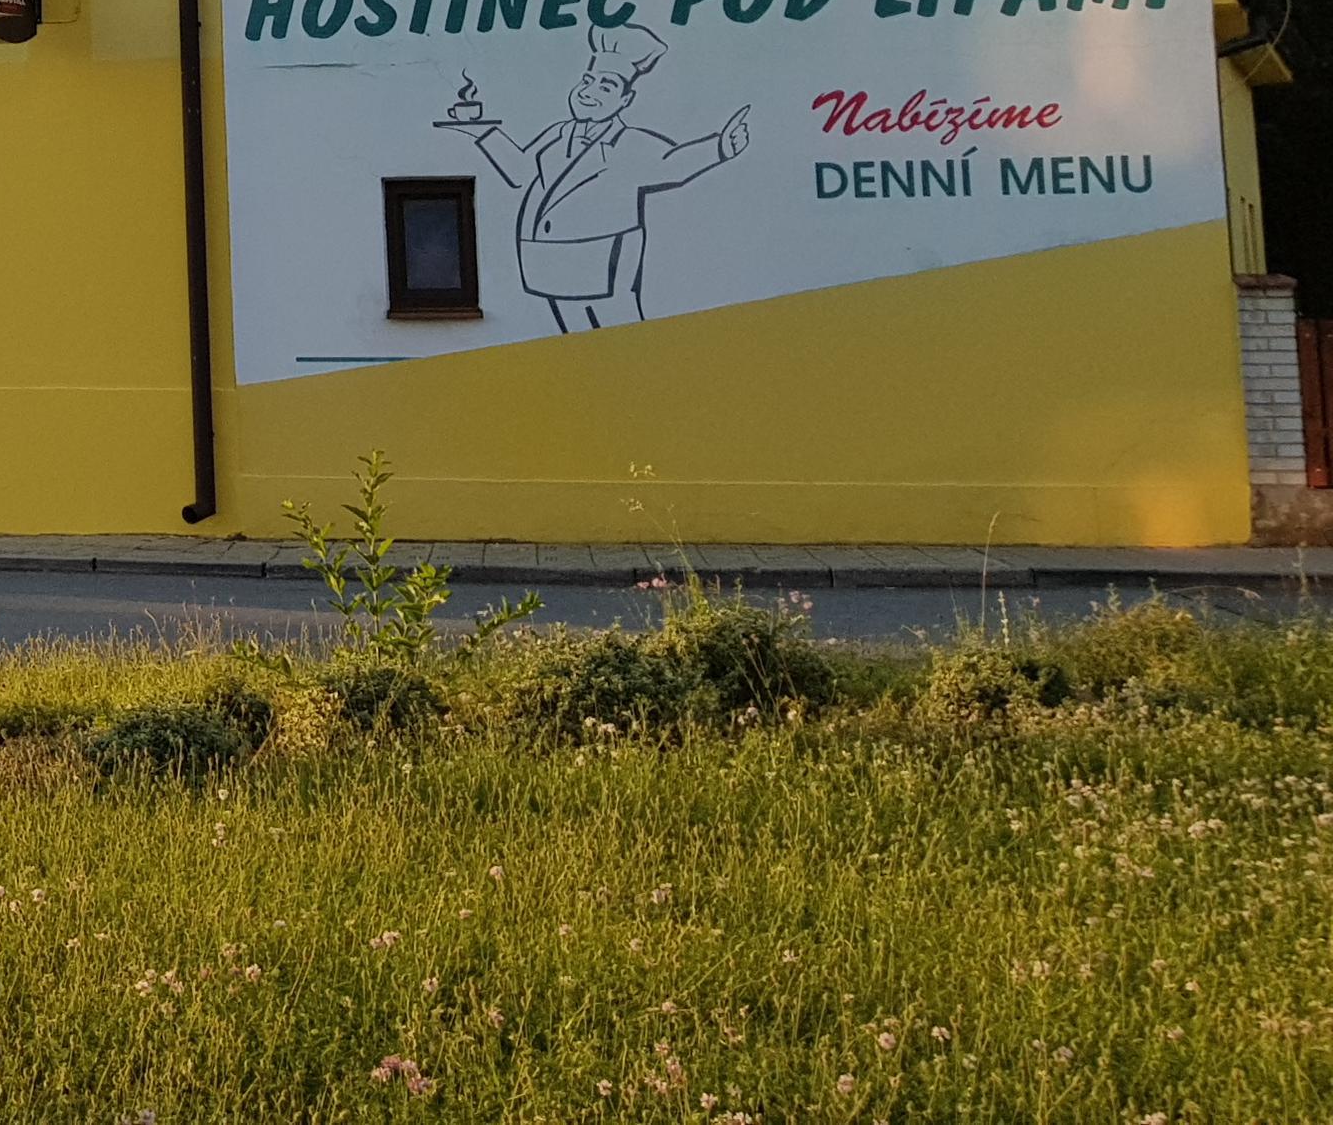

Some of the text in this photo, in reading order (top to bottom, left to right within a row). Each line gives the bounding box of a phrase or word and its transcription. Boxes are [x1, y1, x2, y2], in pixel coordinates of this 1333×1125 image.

[811, 89, 1063, 146] Nabízíme
[814, 146, 1153, 199] DENNÍ MENU
